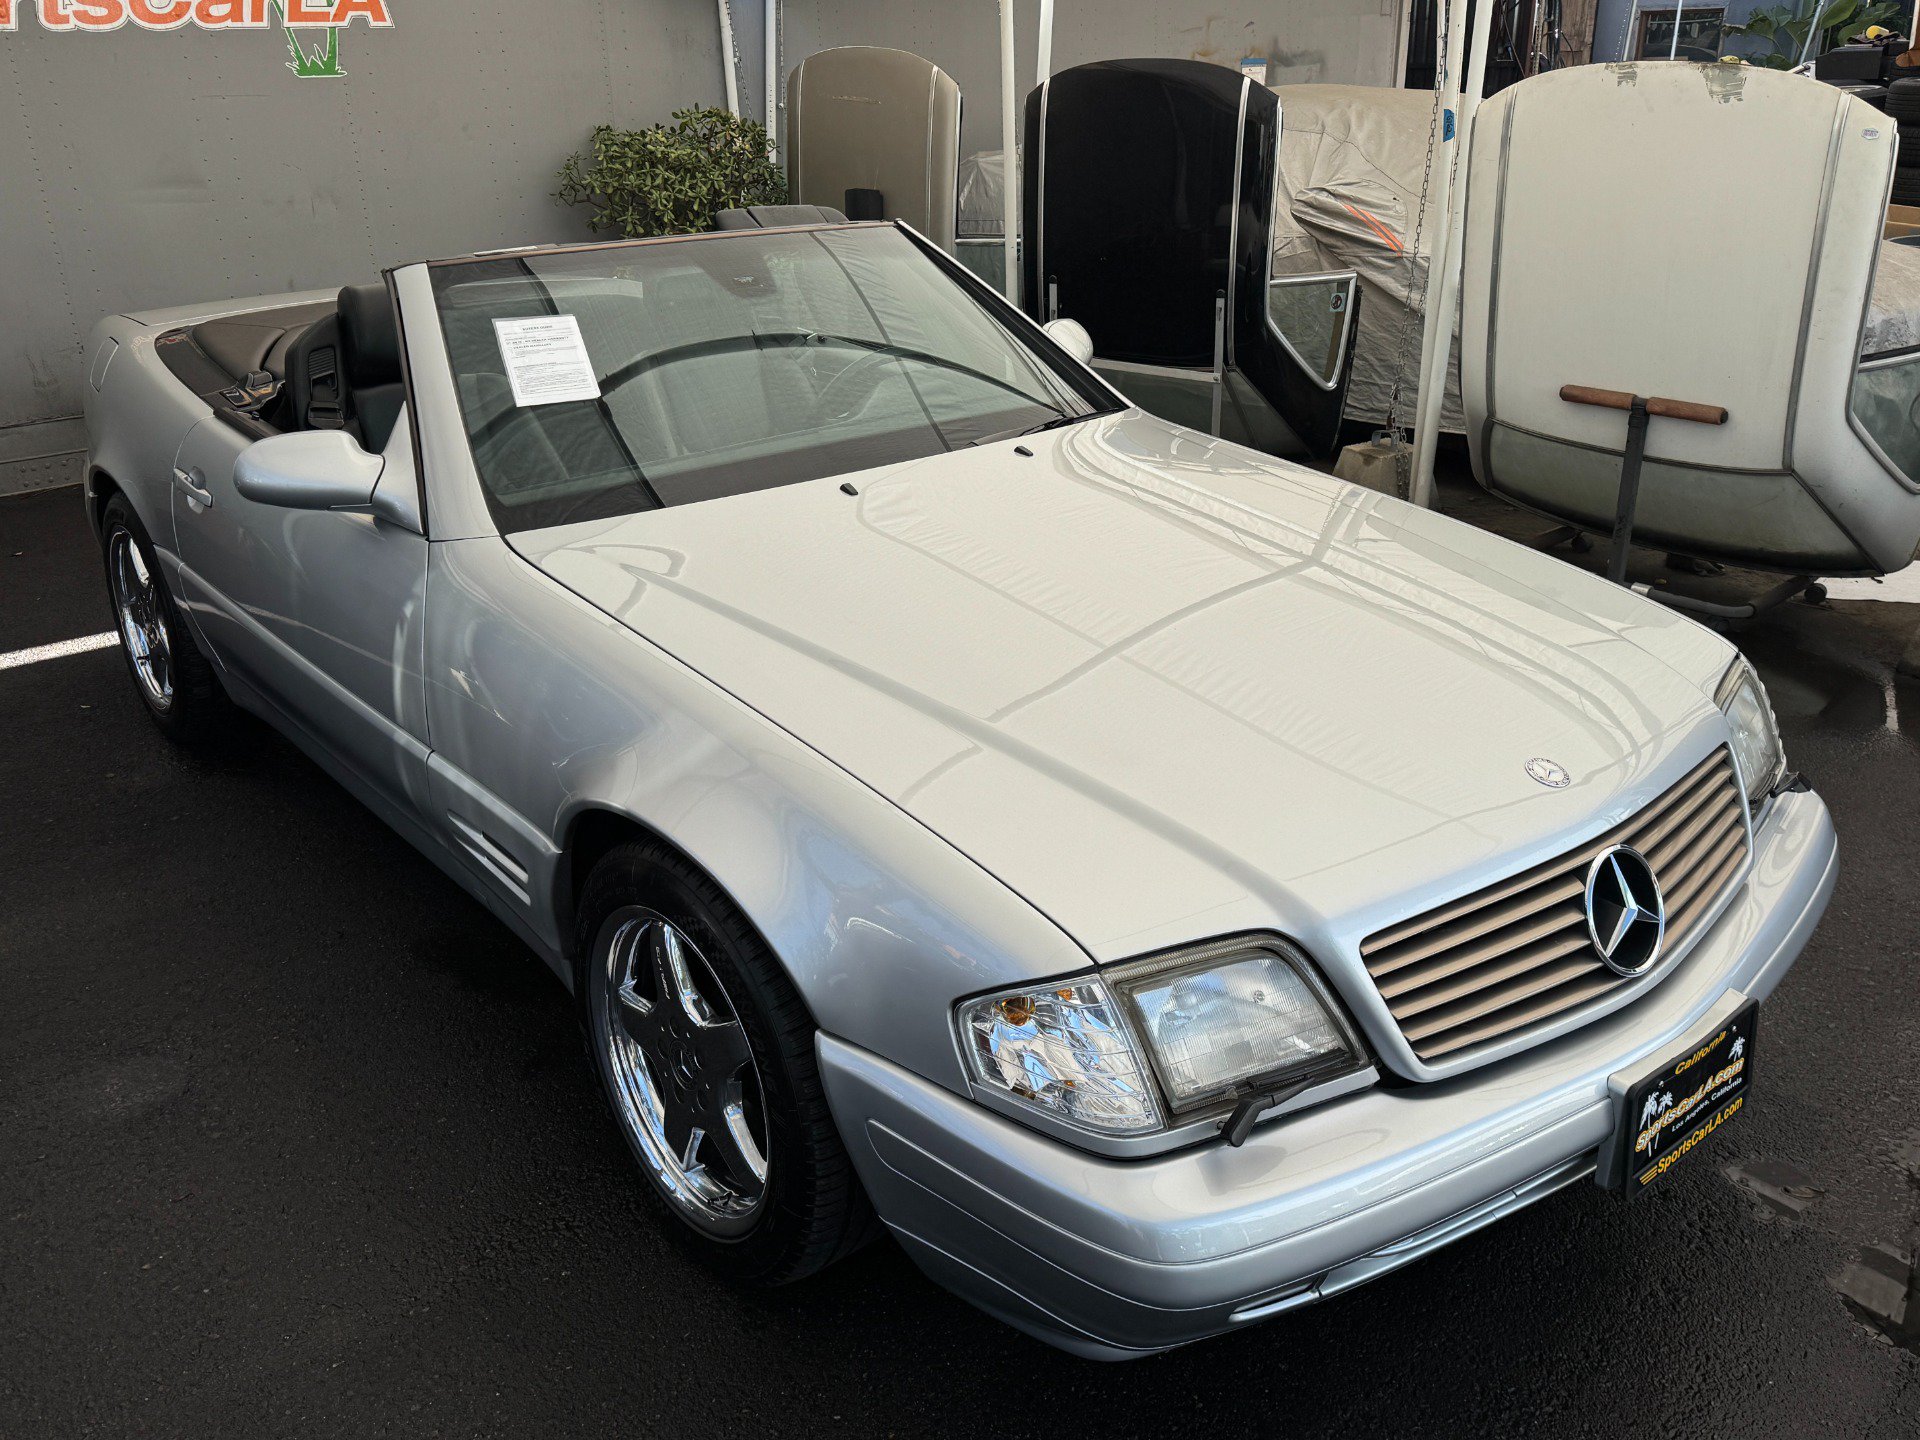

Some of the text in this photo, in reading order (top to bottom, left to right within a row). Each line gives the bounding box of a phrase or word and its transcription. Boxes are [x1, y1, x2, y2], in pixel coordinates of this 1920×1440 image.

[1675, 1030, 1727, 1075] California
[1635, 1058, 1745, 1152] SportsCarLA.com
[1657, 1098, 1743, 1173] SportsCarLA.com
[1671, 1120, 1684, 1132] Los
[1711, 1077, 1743, 1101] California
